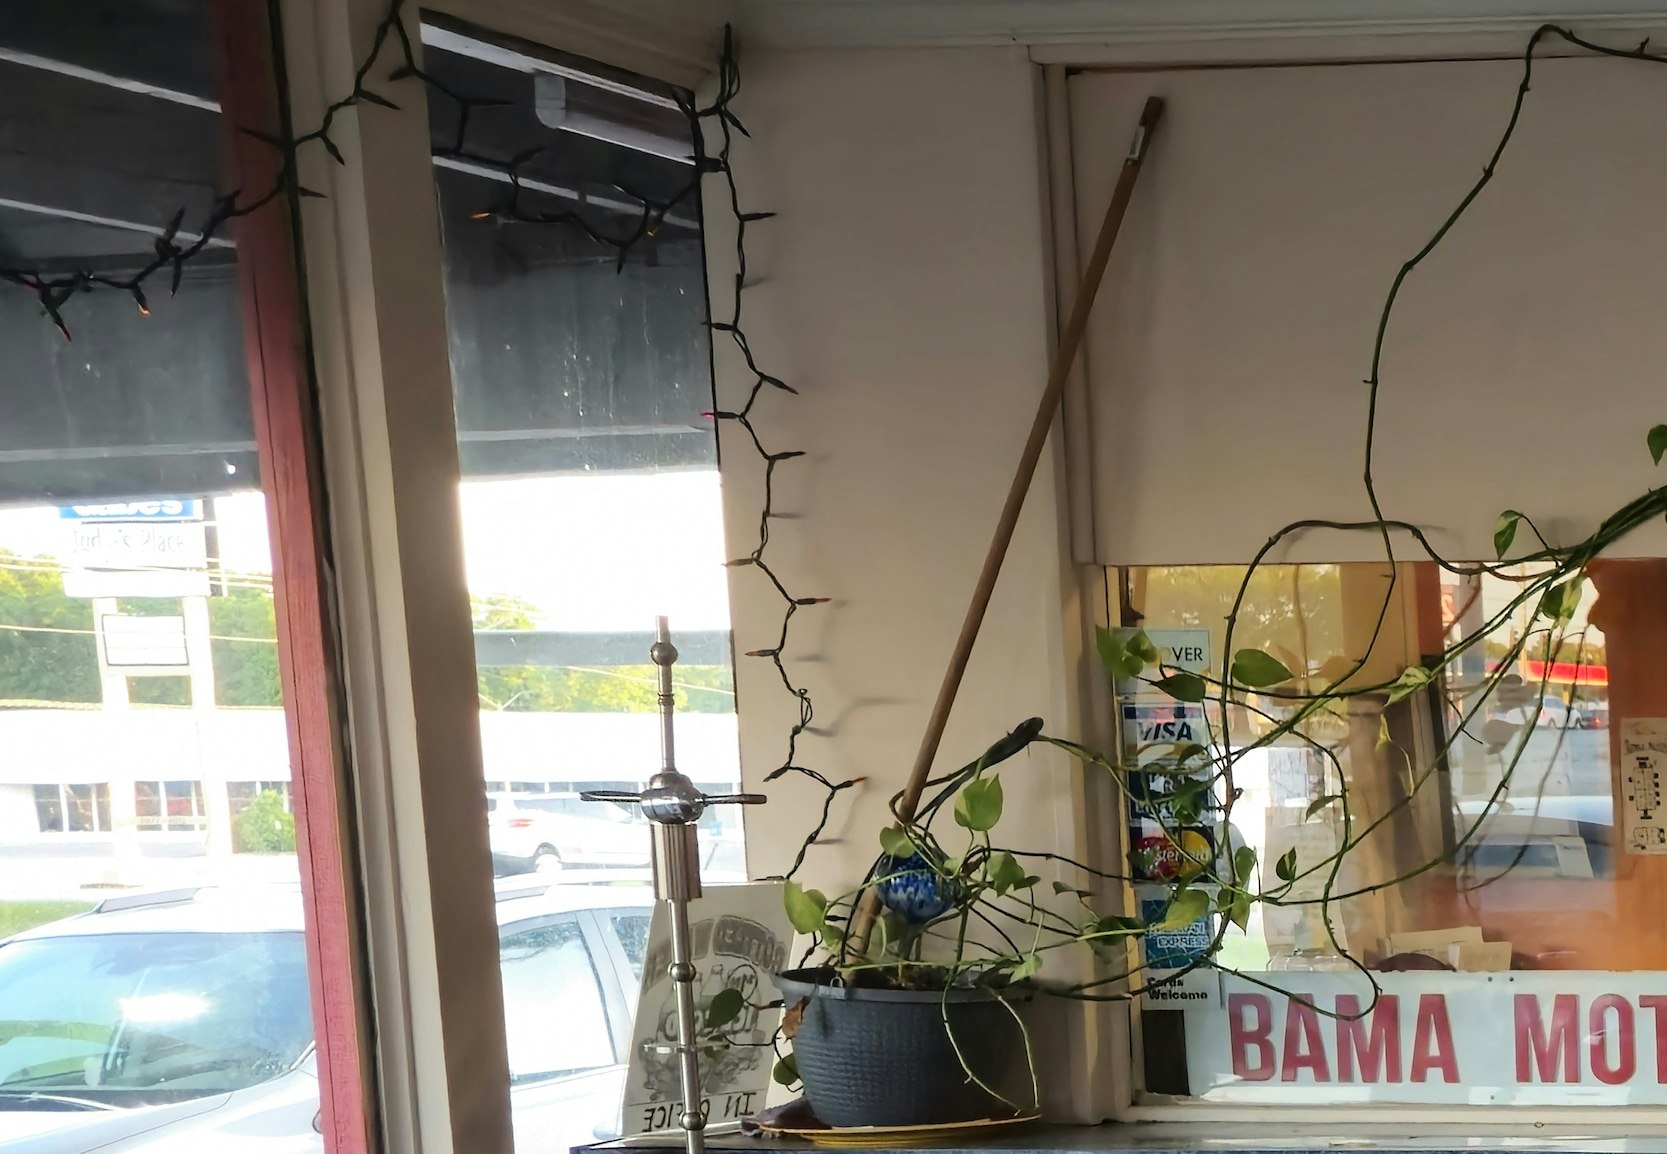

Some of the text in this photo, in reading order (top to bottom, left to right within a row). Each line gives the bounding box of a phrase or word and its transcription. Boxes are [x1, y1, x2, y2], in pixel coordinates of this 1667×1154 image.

[1138, 721, 1192, 741] VISA
[1157, 936, 1209, 948] EXPRESS
[1149, 988, 1208, 1001] Welcome
[1228, 991, 1461, 1085] BAMA
